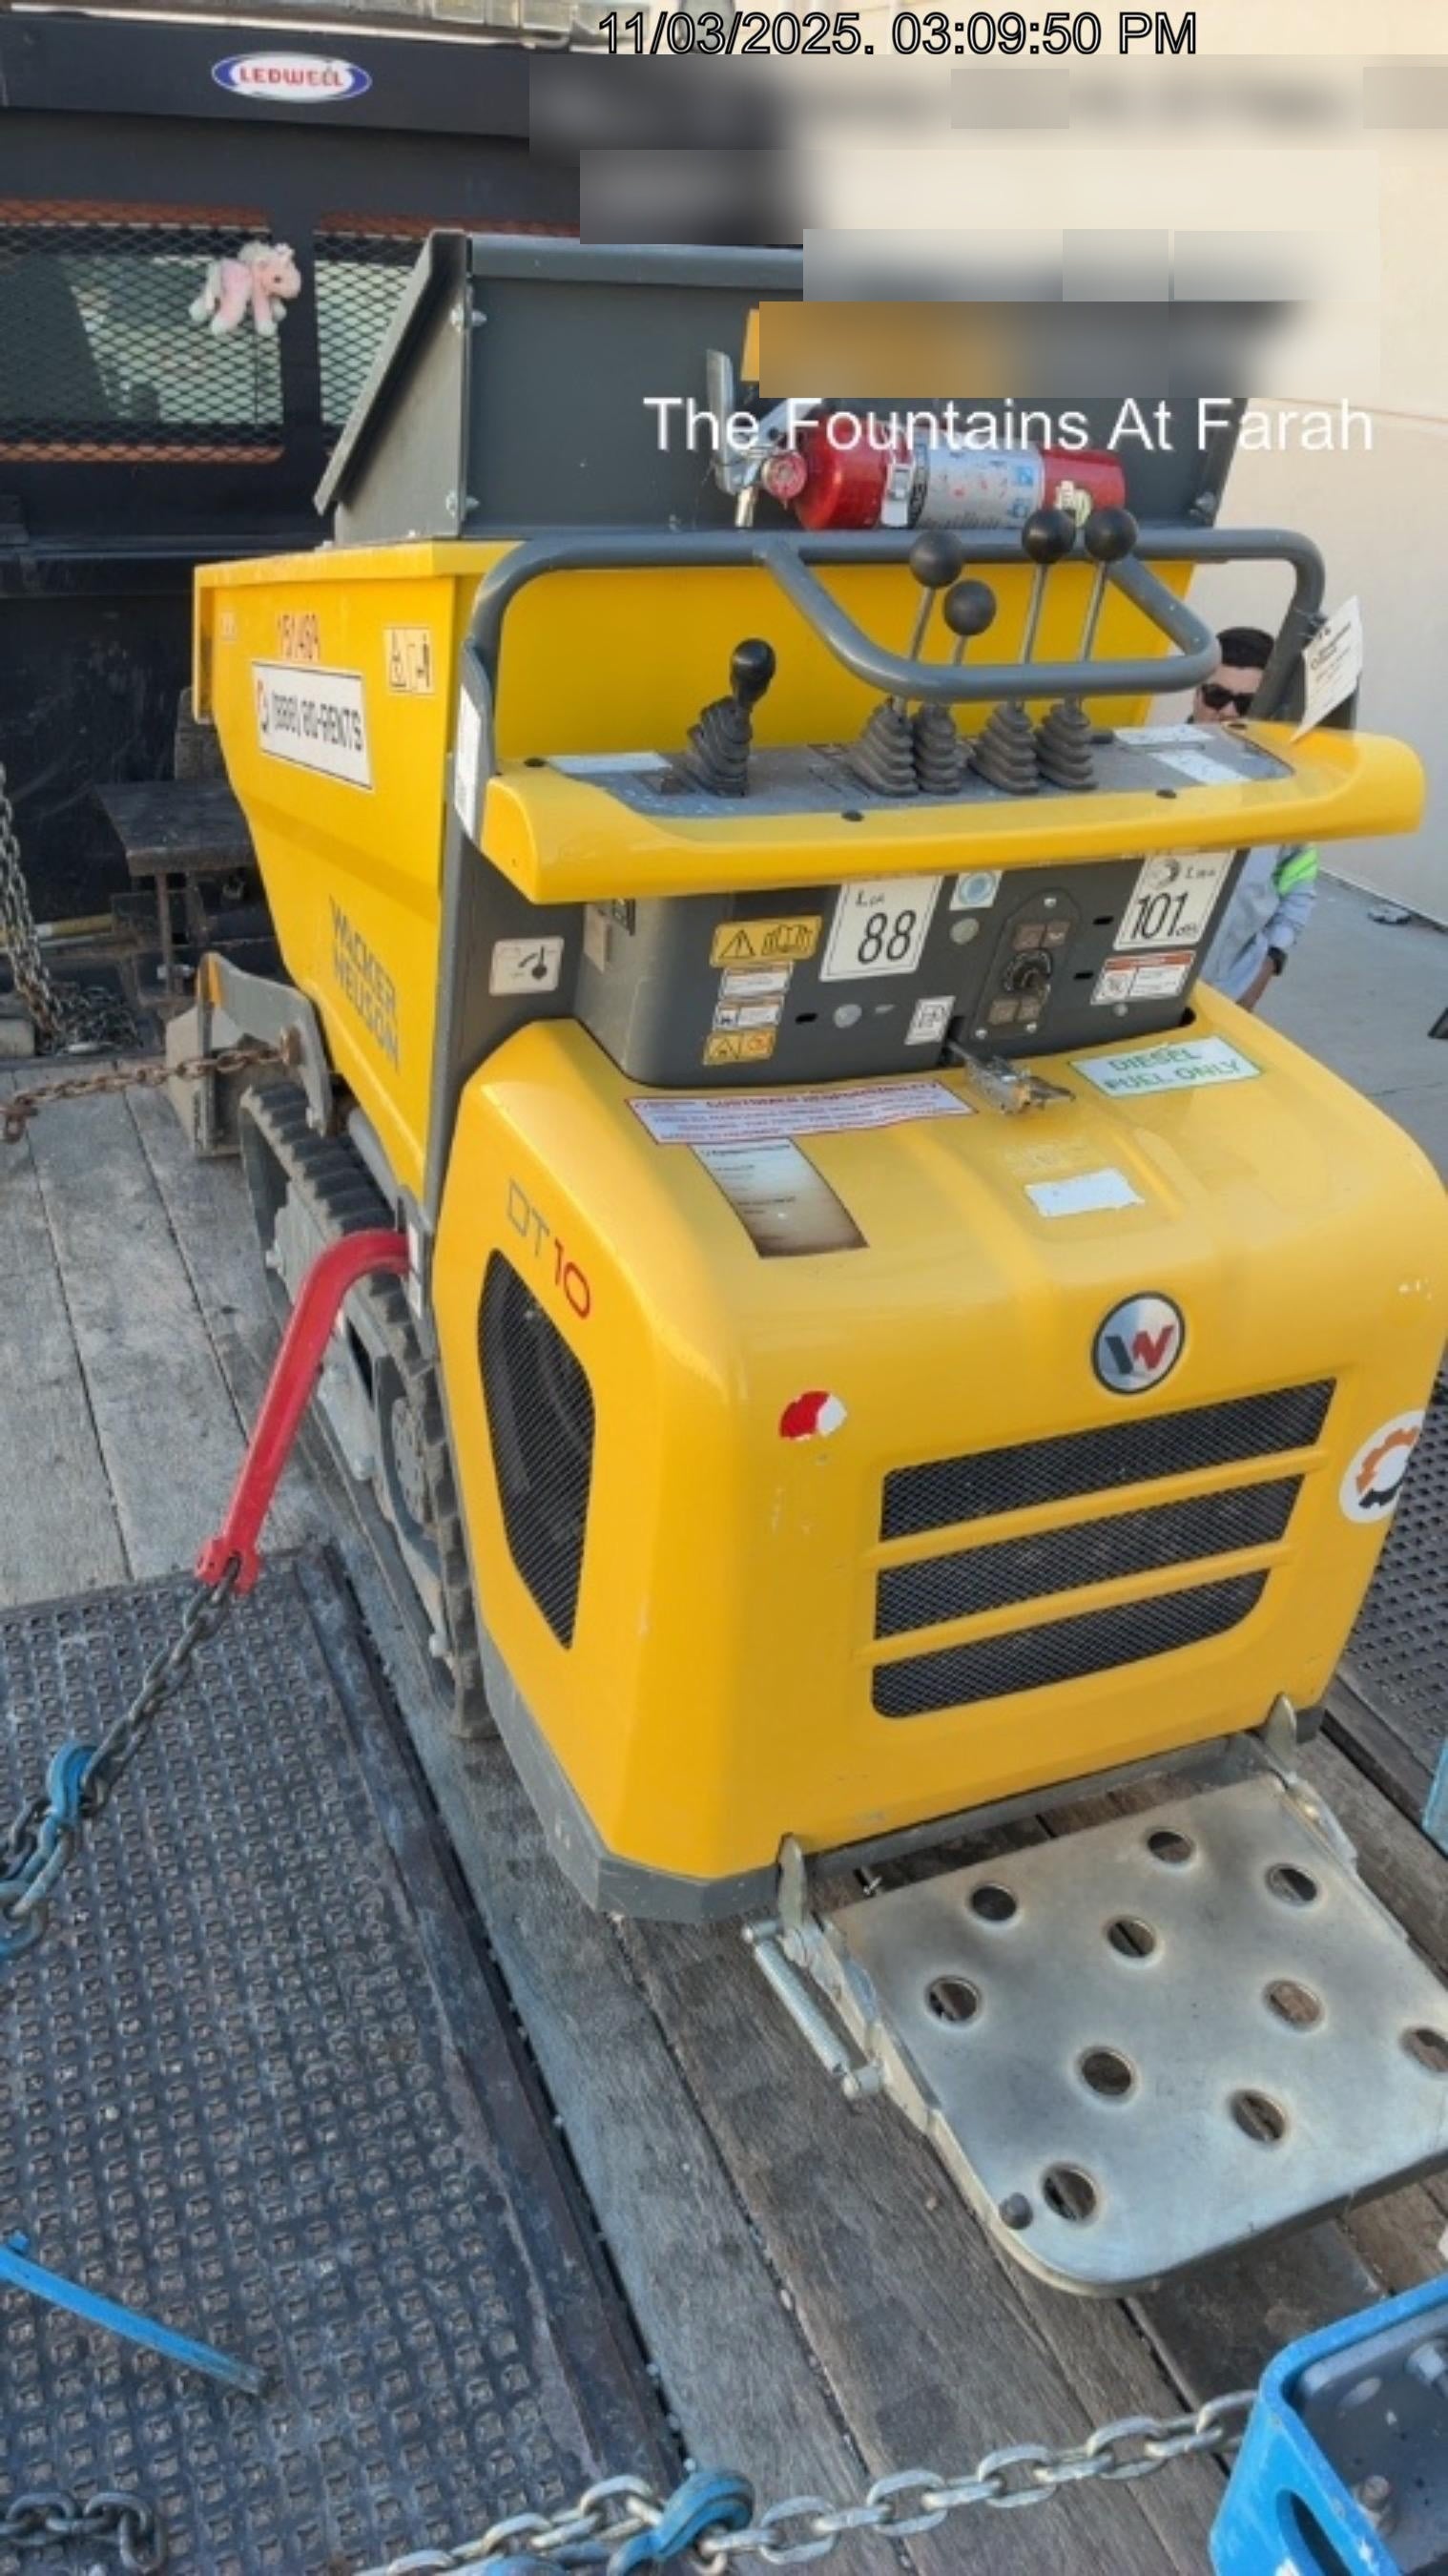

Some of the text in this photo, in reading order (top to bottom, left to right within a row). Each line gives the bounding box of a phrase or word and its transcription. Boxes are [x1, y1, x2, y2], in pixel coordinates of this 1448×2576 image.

[239, 68, 344, 87] LEDWELL
[857, 909, 918, 965] 88
[329, 893, 396, 1014] WACKER
[1104, 1059, 1241, 1091] FUEL ONLY
[1108, 1048, 1203, 1072] DIESEL
